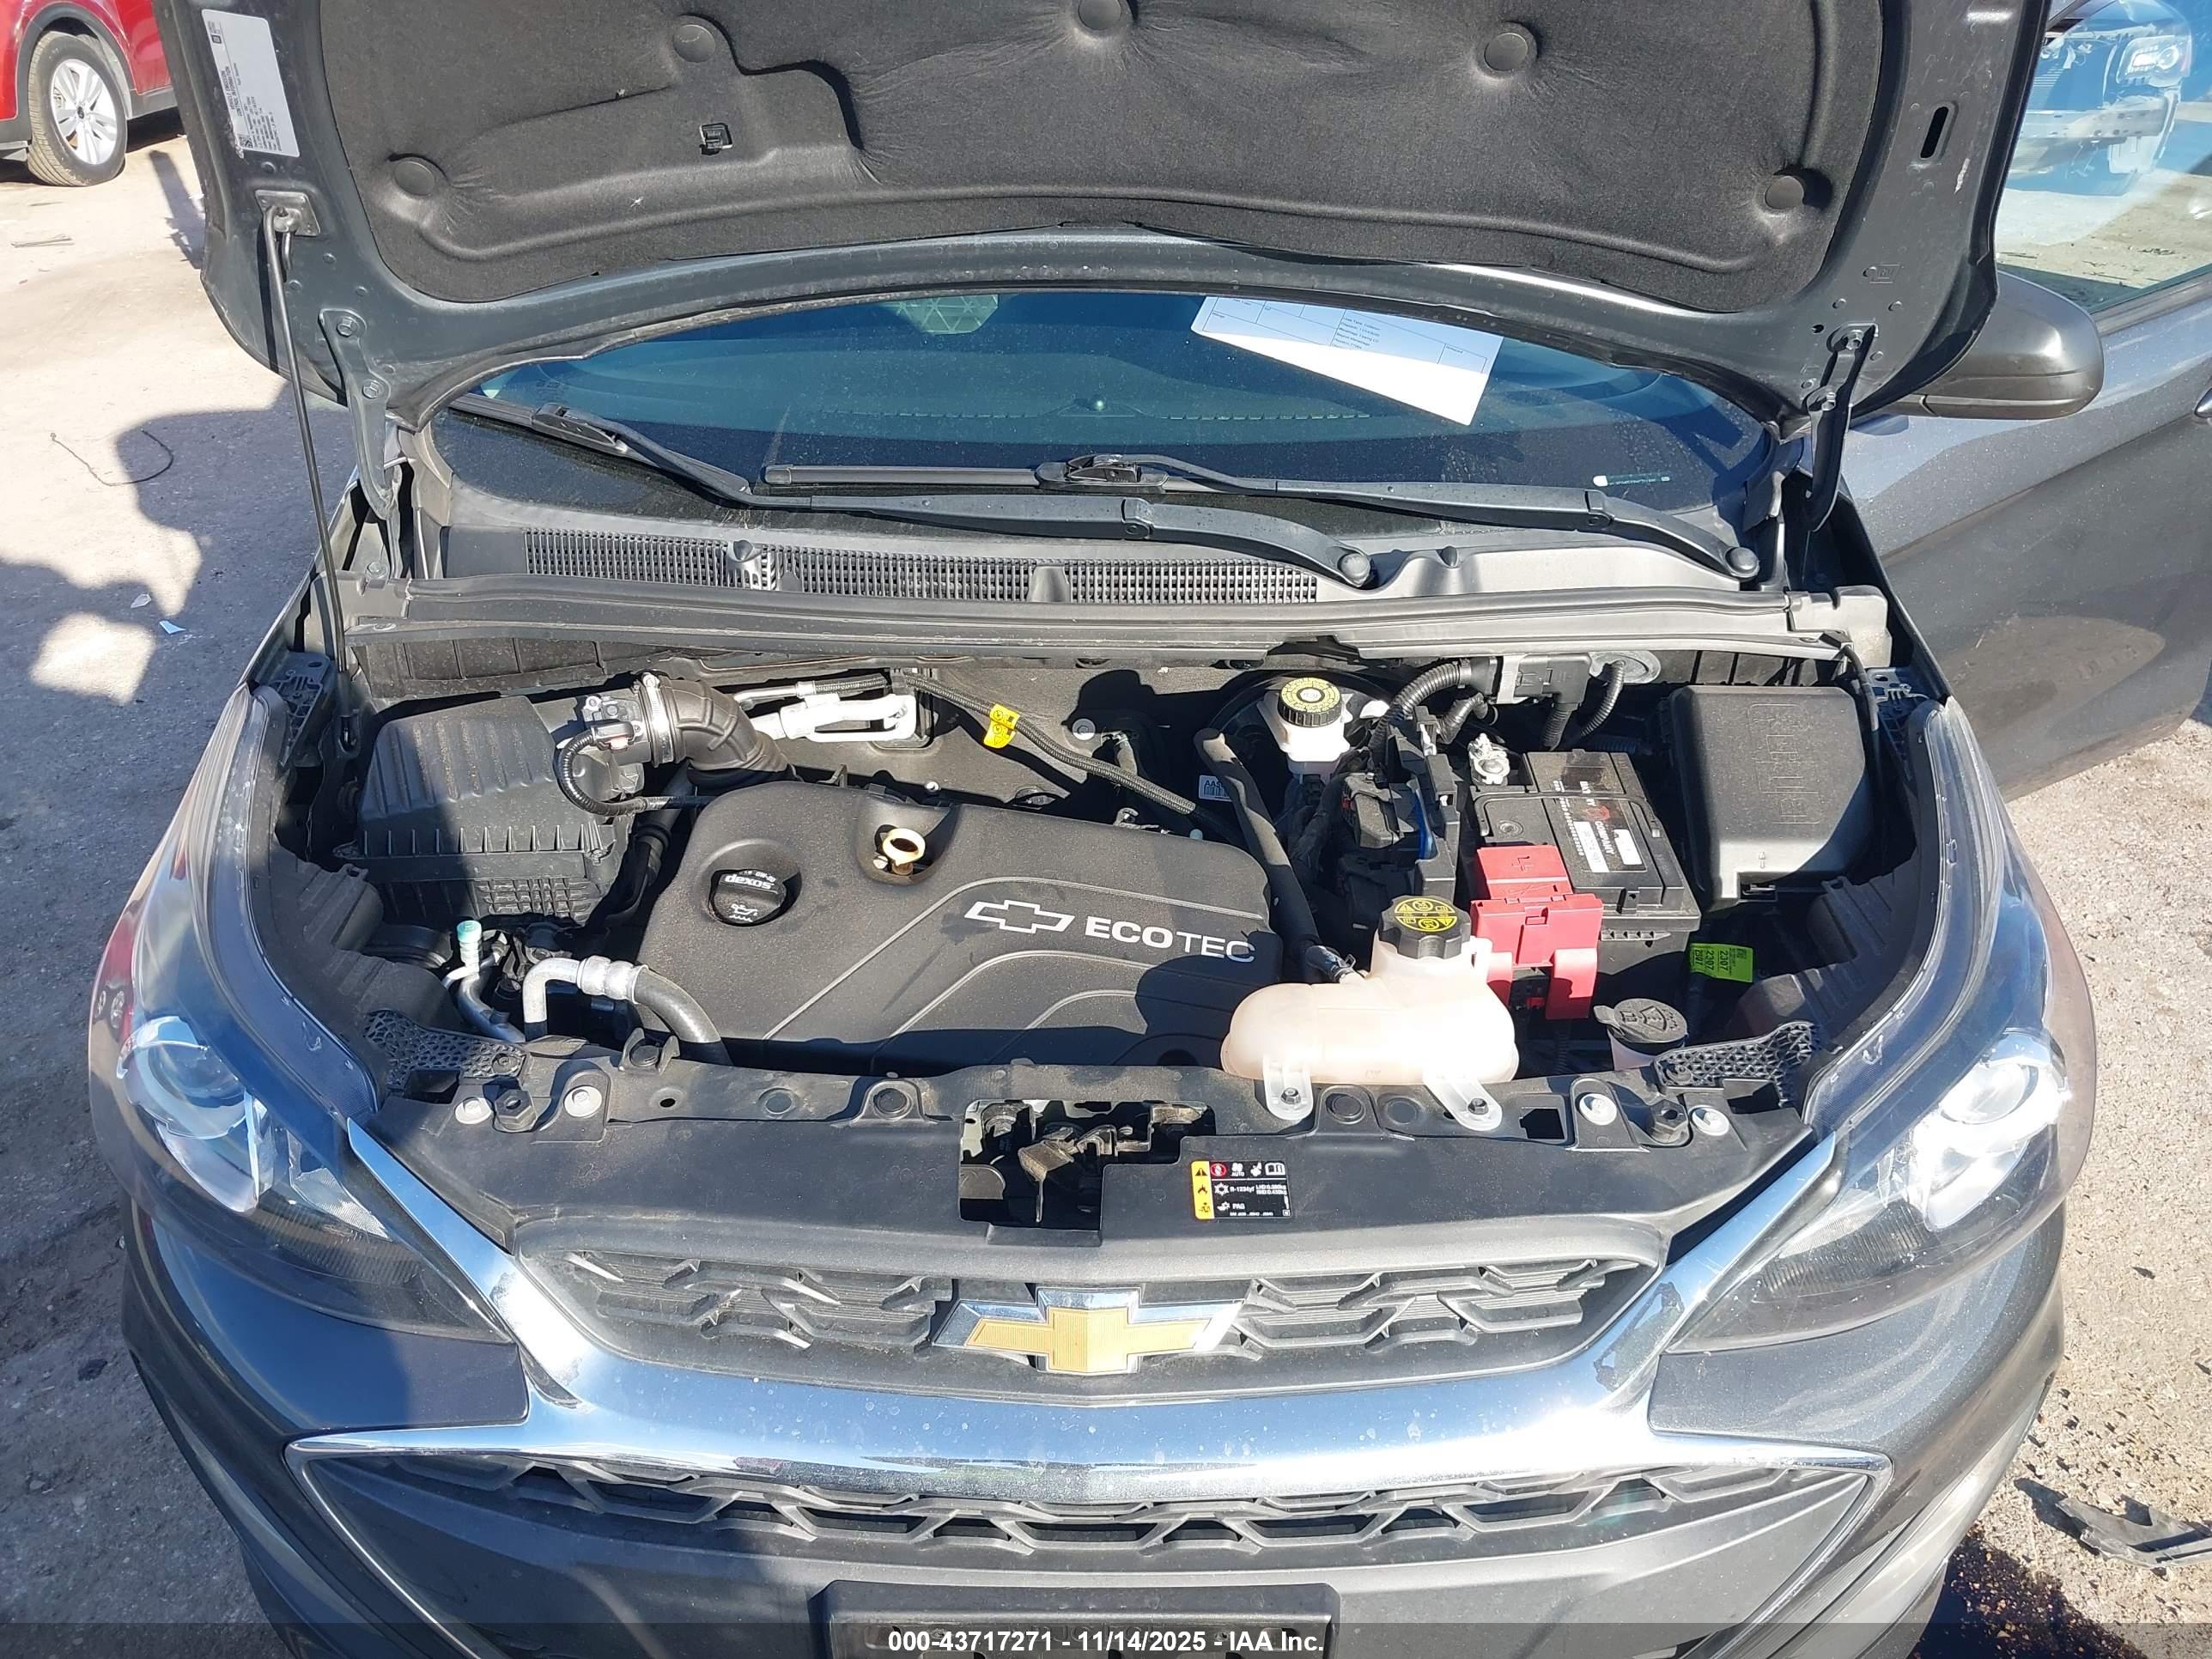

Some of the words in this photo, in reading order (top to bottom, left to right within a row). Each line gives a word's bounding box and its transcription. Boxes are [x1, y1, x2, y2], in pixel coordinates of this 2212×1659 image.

[1595, 820, 1615, 855] COMPANY
[724, 874, 775, 890] dexos
[1085, 915, 1256, 963] ECOTEC
